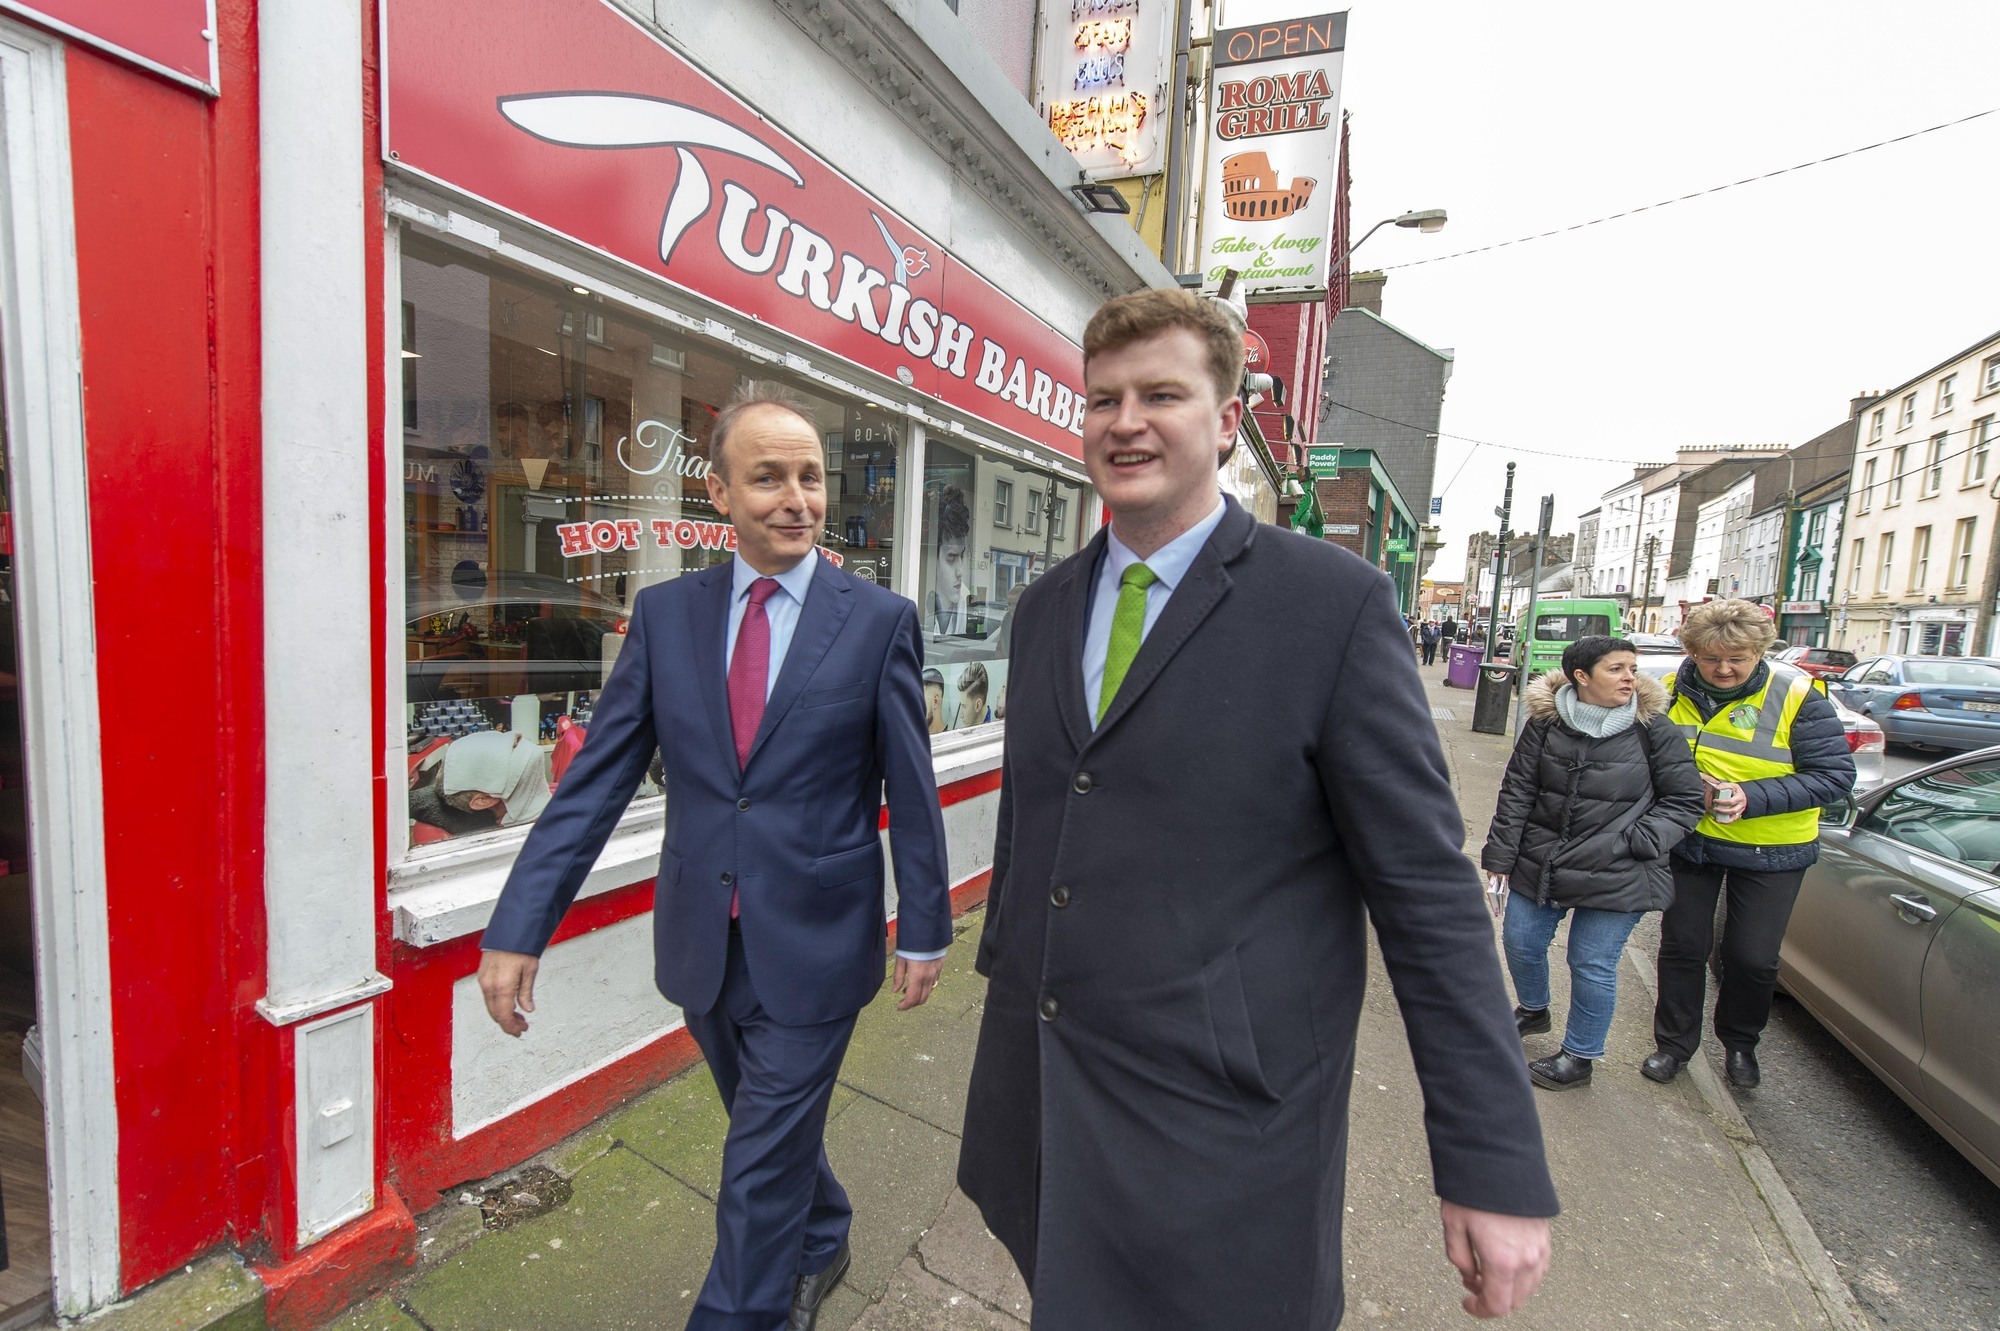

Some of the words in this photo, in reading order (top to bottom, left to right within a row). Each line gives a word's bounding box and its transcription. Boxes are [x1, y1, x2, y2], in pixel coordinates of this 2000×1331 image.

[1228, 20, 1332, 61] OPEN
[1217, 69, 1334, 113] ROMA
[1216, 99, 1331, 140] GRILL
[1211, 236, 1258, 254] Take
[1259, 233, 1323, 253] Away
[1253, 251, 1275, 268] &
[497, 90, 974, 379] TURKISH
[975, 336, 1087, 438] BARBE
[1207, 263, 1315, 281] Rstaurant
[617, 420, 712, 480] Tra
[1309, 453, 1337, 461] Paddy
[557, 519, 642, 558] HOT
[651, 519, 738, 551] TOWE
